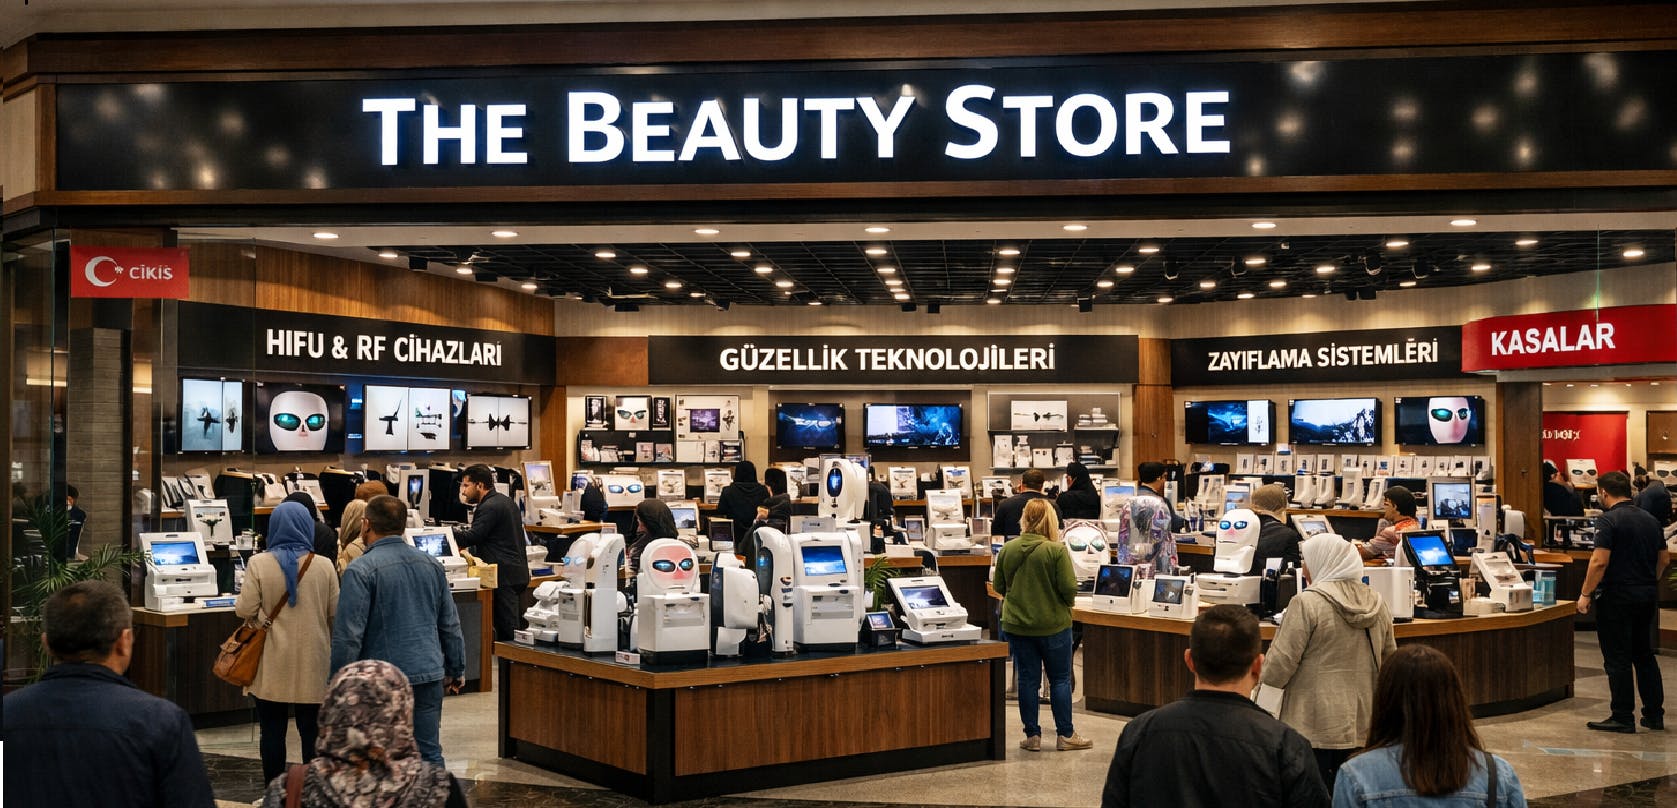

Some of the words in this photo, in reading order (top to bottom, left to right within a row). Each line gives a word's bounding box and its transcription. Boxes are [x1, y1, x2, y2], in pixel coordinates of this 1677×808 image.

[362, 98, 528, 165] THE
[568, 91, 916, 163] BEAUTY
[944, 84, 1231, 159] STORE
[266, 328, 324, 359] HIFU
[331, 335, 348, 360] &
[356, 335, 386, 361] RF
[1491, 322, 1616, 356] KASALAR
[719, 343, 848, 371] GÜZELLİK
[855, 342, 1056, 371] TEKNOLOJİLERİ
[1207, 348, 1313, 371] ZAYIFLAMA
